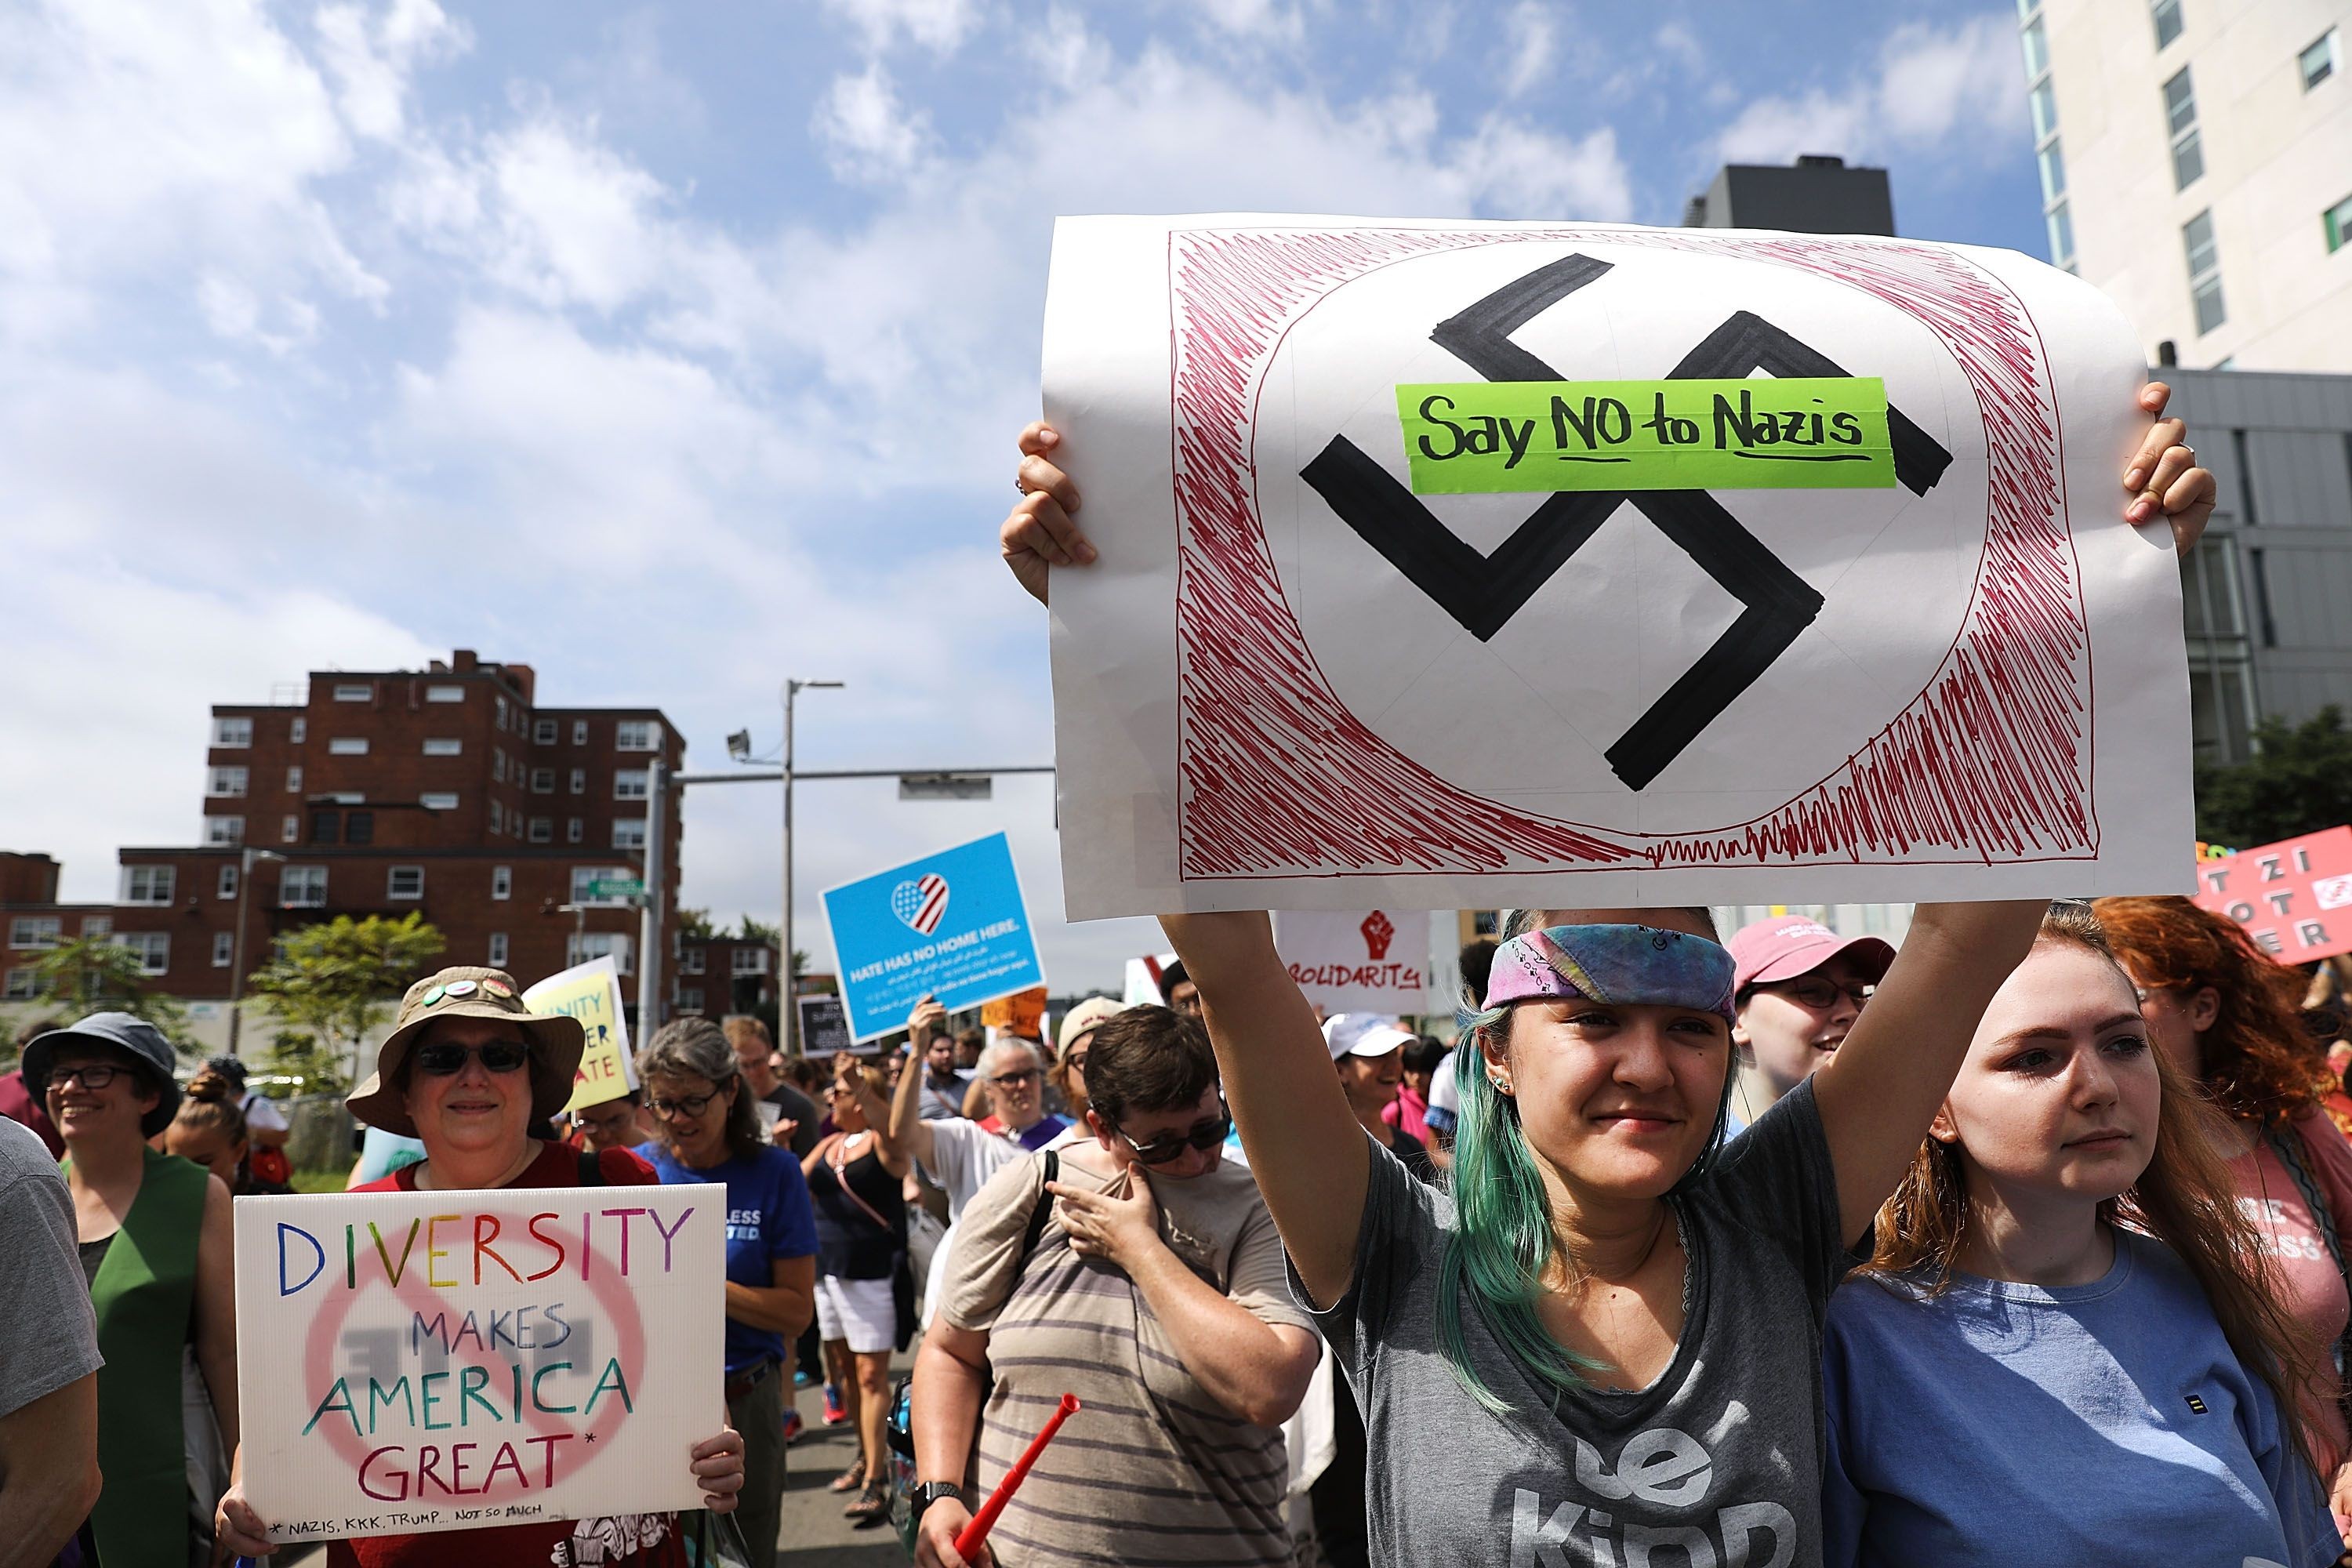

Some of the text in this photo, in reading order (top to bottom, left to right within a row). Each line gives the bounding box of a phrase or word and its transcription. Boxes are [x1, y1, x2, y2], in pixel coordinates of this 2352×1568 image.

[1418, 390, 1863, 469] Say NO to Nazis
[2224, 889, 2294, 924] OT
[2249, 917, 2332, 954] ER
[851, 960, 885, 984] HATE
[884, 951, 914, 971] HAS
[913, 945, 937, 963] NO
[936, 930, 981, 954] HOME
[586, 1025, 610, 1048] ER
[575, 1056, 615, 1085] ATE
[726, 1210, 760, 1225] ESS
[278, 1207, 695, 1297] DIVERSITY
[412, 1302, 572, 1356] MAKES
[302, 1357, 633, 1436] AMERICA
[289, 1520, 340, 1536] NAZIS,
[456, 1509, 483, 1521] NOT
[485, 1508, 499, 1517] SO
[506, 1504, 543, 1517] MUCH
